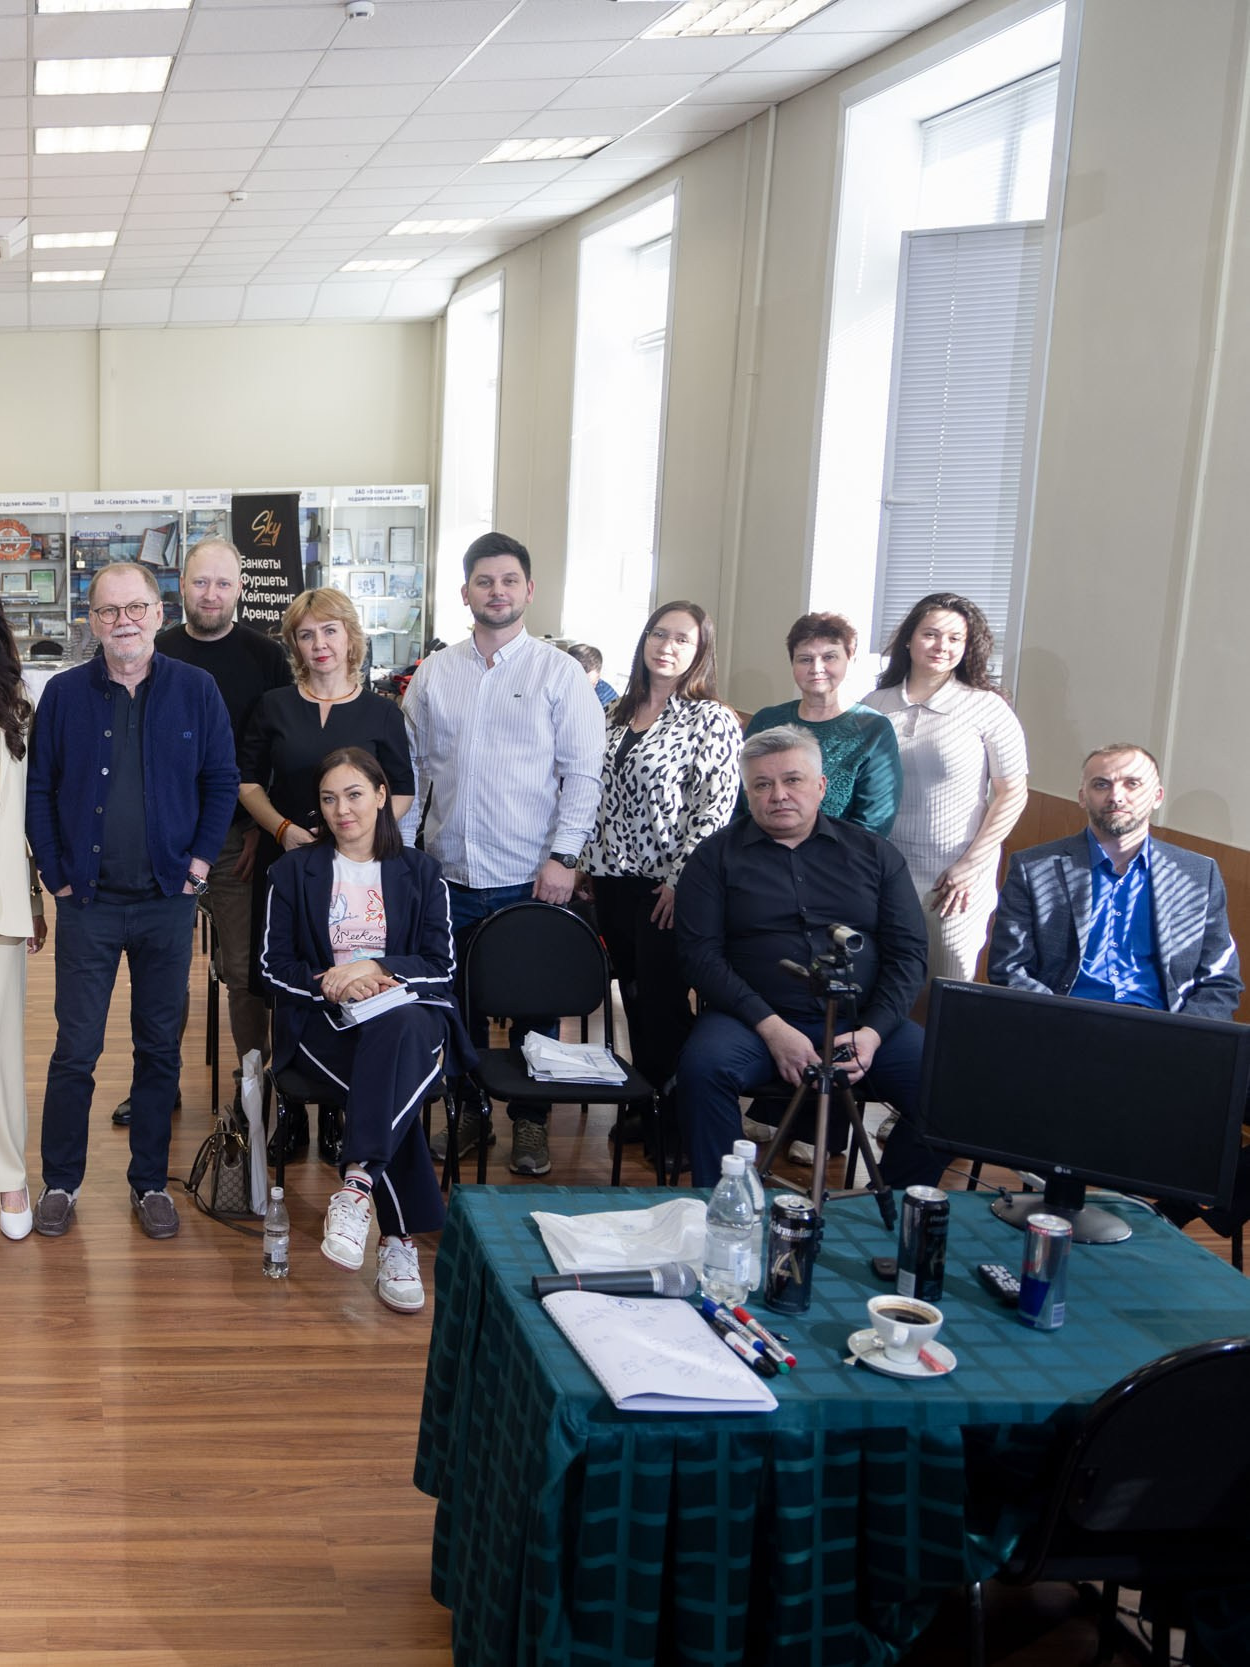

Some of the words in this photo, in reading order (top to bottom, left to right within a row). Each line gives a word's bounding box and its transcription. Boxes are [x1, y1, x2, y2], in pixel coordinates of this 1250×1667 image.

[251, 509, 282, 547] Sky
[240, 555, 281, 570] Банкеты
[240, 572, 288, 588] Фуршеты
[241, 589, 295, 606] Кейтеринг
[241, 605, 280, 621] Аренда
[332, 925, 387, 945] Weeken
